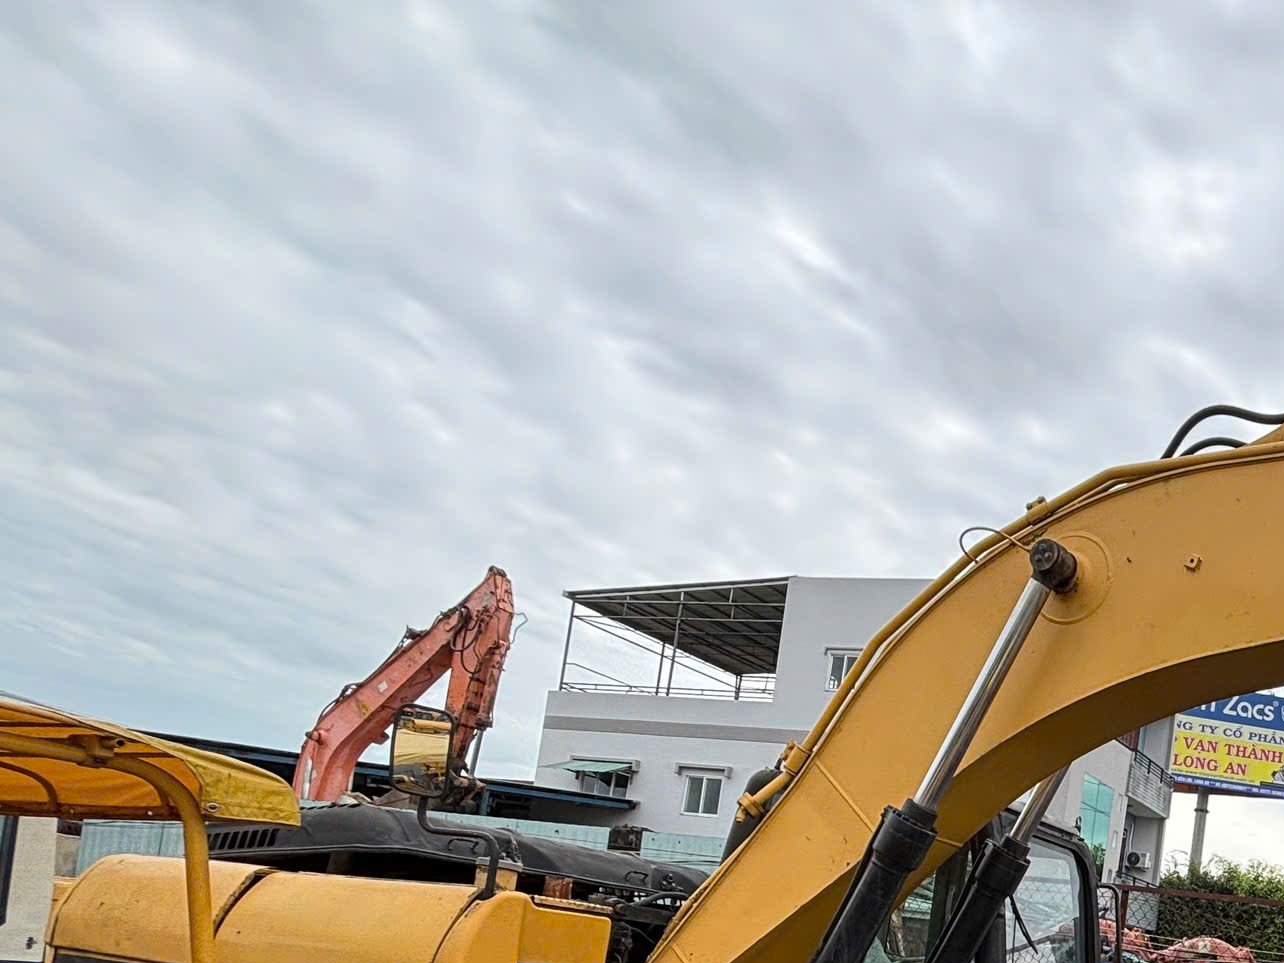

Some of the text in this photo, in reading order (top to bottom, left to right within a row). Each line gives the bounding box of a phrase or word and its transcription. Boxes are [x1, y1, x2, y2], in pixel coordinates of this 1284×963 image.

[1198, 723, 1219, 735] TY
[1224, 743, 1284, 764] THÀNH
[1172, 753, 1219, 771] LONG
[1223, 763, 1248, 776] AN
